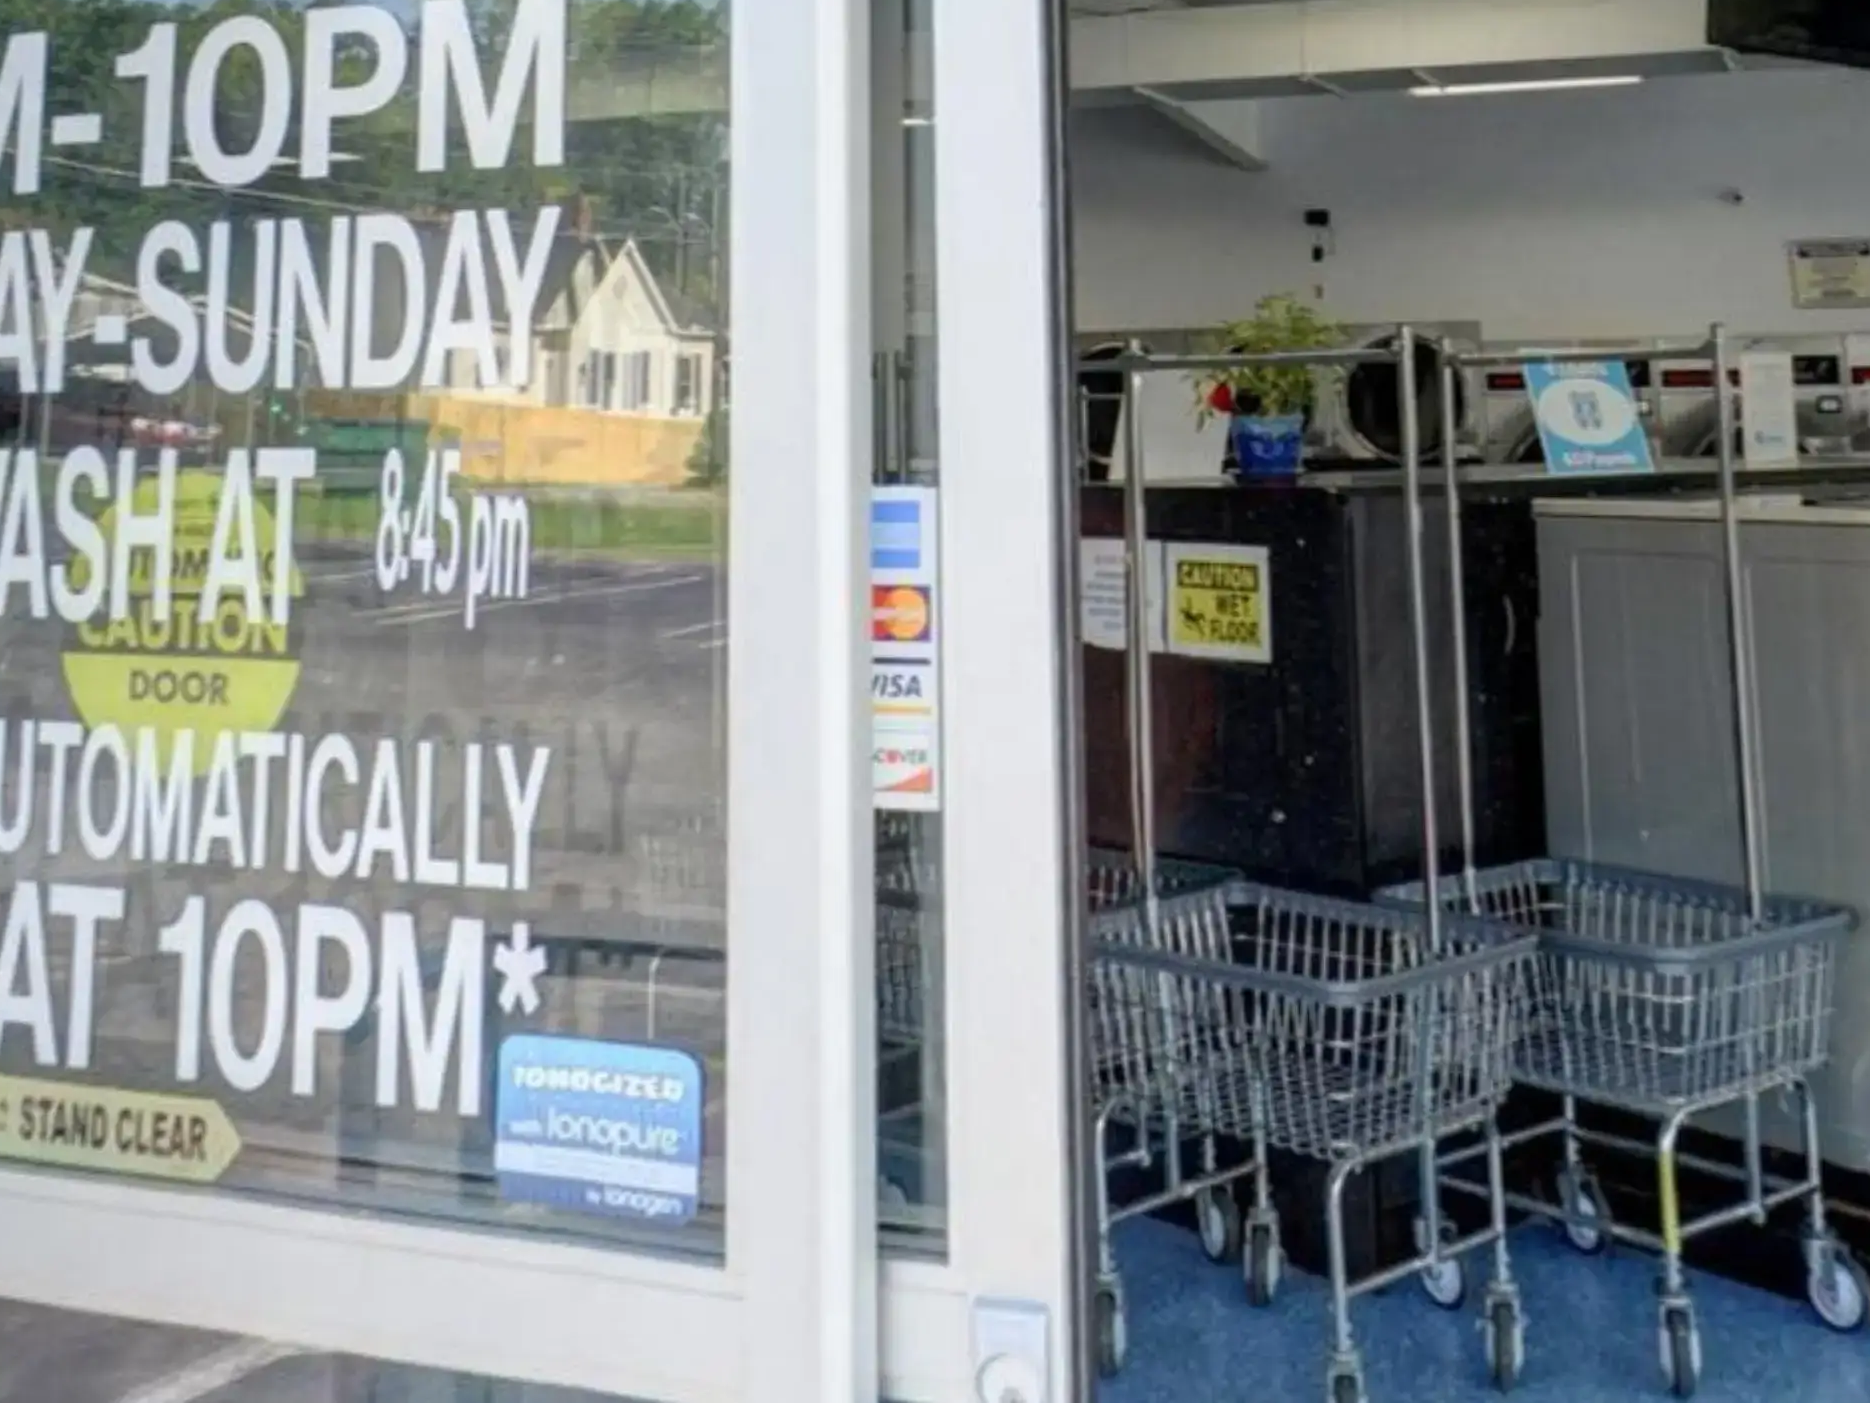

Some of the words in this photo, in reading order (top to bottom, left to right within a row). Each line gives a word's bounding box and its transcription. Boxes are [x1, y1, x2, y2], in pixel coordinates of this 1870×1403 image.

[198, 447, 317, 627] AT
[78, 596, 288, 654] CAUTION
[128, 669, 231, 706] DOOR
[18, 1097, 108, 1149] STAND
[113, 1109, 207, 1162] CLEAR
